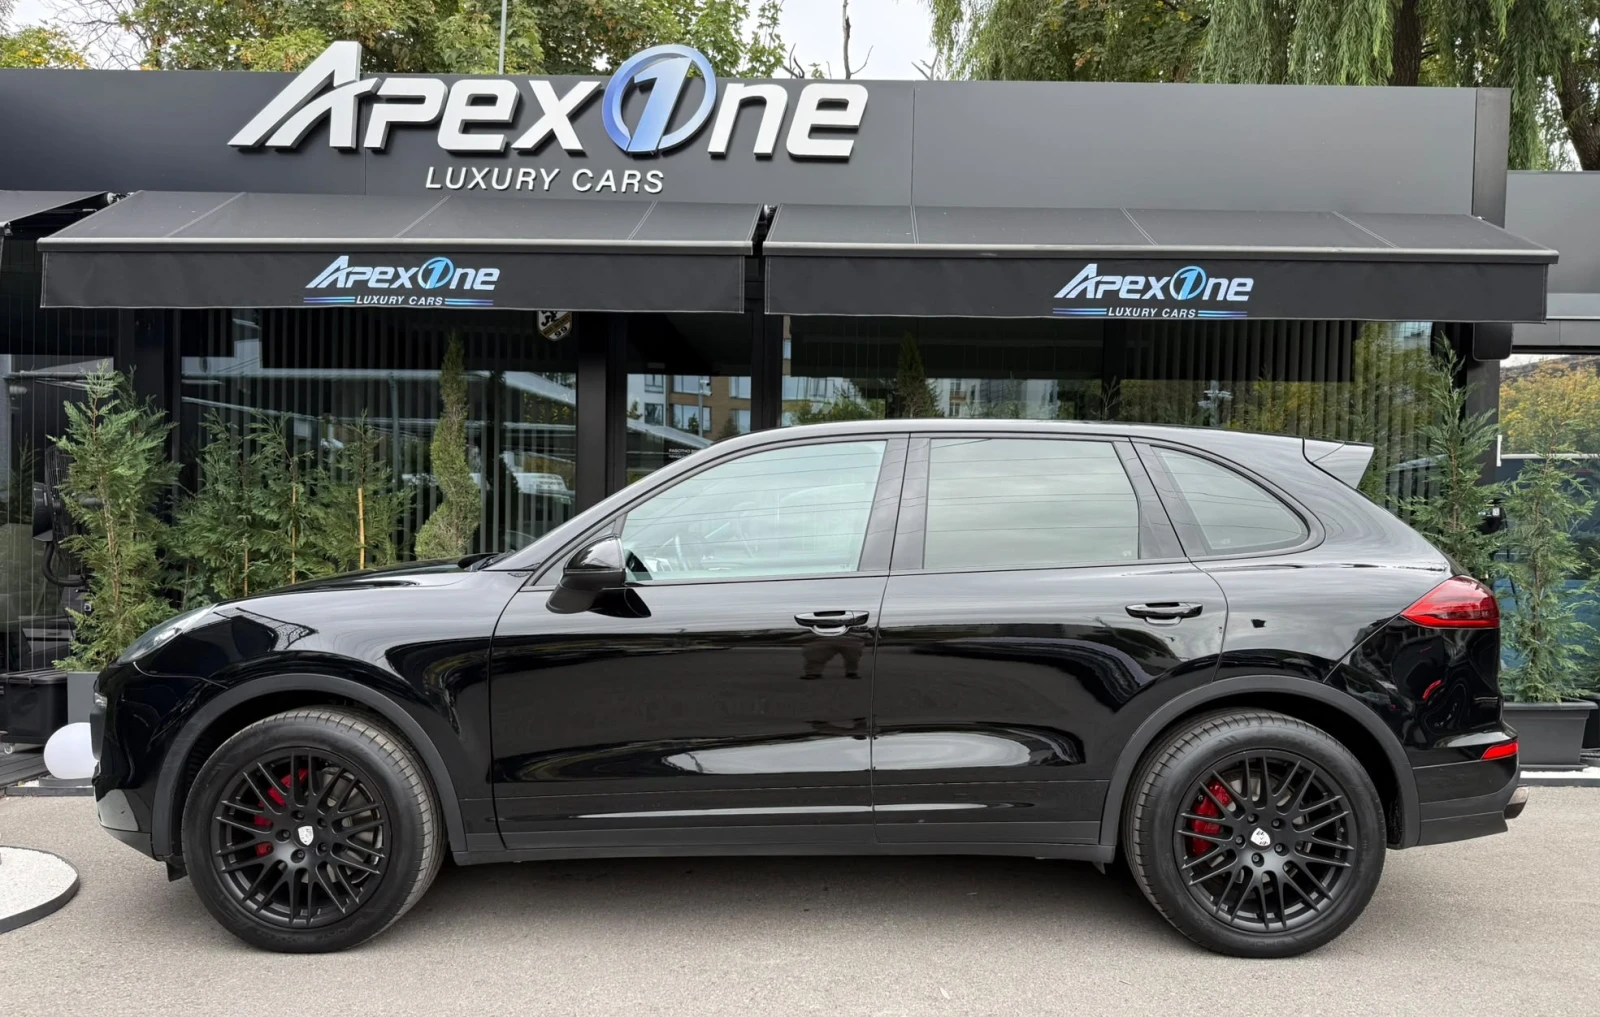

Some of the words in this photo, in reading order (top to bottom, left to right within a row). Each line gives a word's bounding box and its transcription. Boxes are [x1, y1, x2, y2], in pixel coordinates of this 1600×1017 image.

[425, 166, 560, 192] LUXURY
[571, 168, 665, 194] CARS
[356, 295, 405, 305] LUXURY
[408, 296, 443, 306] CARS
[1108, 306, 1158, 317] LUXURY
[1161, 308, 1197, 319] CARS
